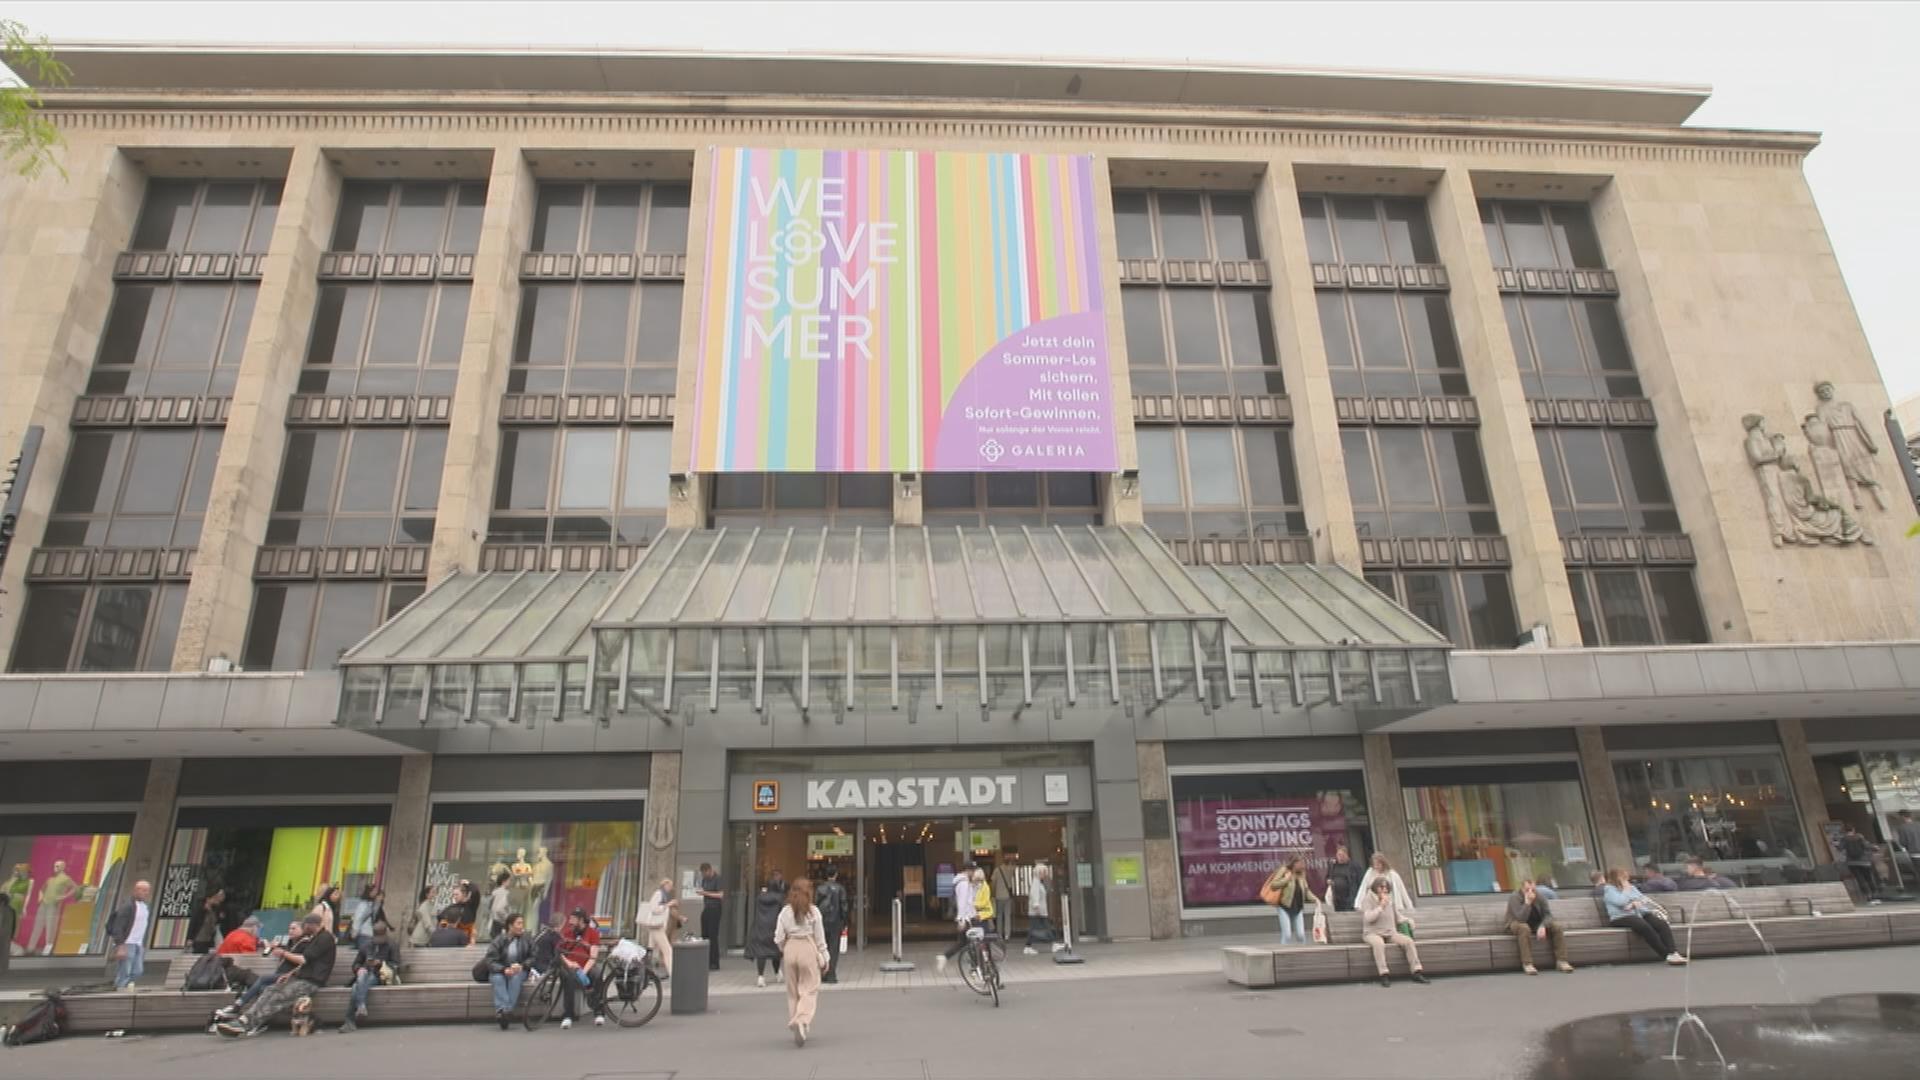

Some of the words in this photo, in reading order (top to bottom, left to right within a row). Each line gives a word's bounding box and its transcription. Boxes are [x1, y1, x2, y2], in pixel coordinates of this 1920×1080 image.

[750, 177, 845, 217] WE
[750, 218, 899, 265] LOVE
[746, 266, 877, 311] SUM
[743, 314, 873, 361] MER
[1022, 336, 1059, 349] Jetzt
[1063, 336, 1095, 349] dein
[1002, 353, 1097, 366] Sommer-Los
[1040, 371, 1098, 384] sichern.
[1029, 388, 1052, 401] Mit
[1057, 388, 1100, 401] tollen
[965, 407, 1101, 420] Sofort-Gewinnen.
[1011, 445, 1086, 457] GALERIA
[807, 776, 1017, 809] KARSTADT
[1216, 813, 1311, 831] SONNTAGS
[1218, 830, 1312, 848] SHOPPING
[168, 866, 191, 880] WE
[428, 862, 449, 874] WE
[1188, 863, 1208, 875] AM
[163, 890, 193, 904] SUM
[160, 903, 190, 916] MER
